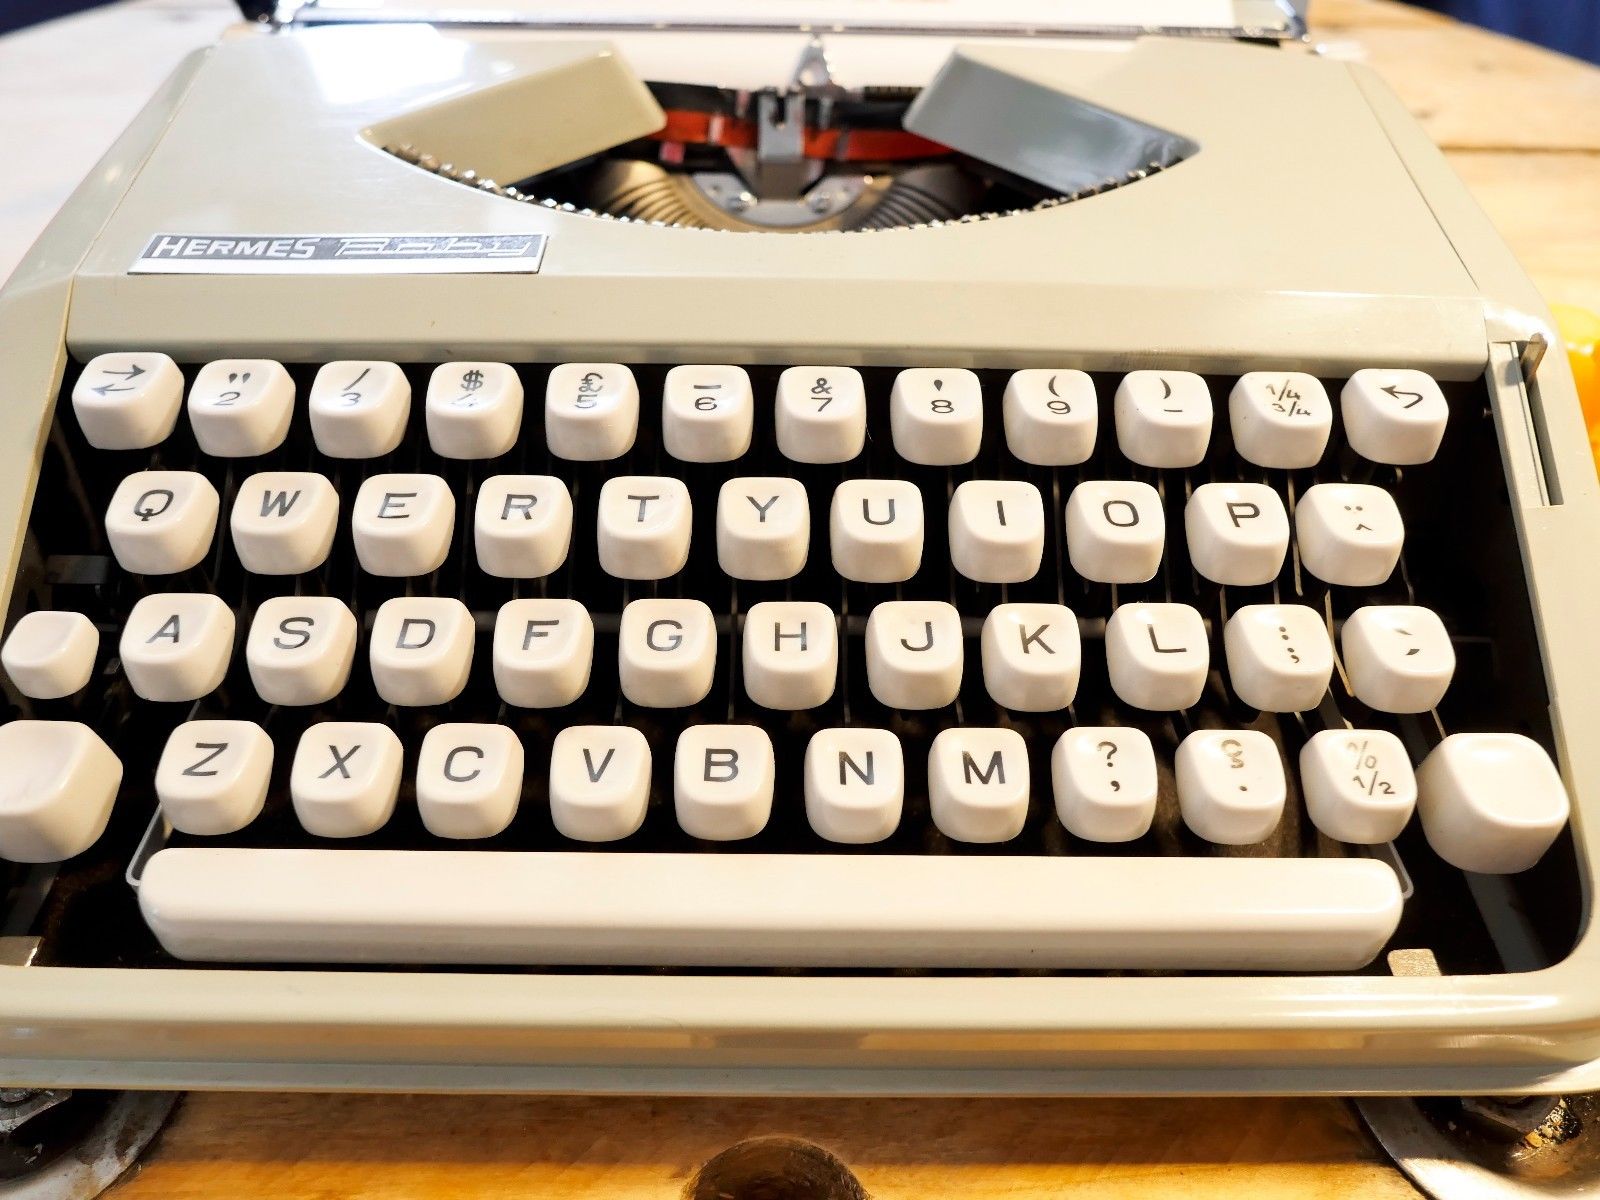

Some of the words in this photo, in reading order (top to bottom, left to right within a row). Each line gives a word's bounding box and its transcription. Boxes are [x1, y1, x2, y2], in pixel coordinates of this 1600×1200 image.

[151, 236, 321, 259] HERMES
[460, 369, 485, 391] $
[578, 372, 604, 392] £
[811, 377, 832, 394] &
[1048, 376, 1059, 396] (
[1160, 378, 1171, 399] )
[213, 391, 241, 406] 2
[341, 389, 362, 406] 3
[574, 394, 598, 409] 5
[695, 397, 717, 411] 6
[811, 397, 832, 412] 7
[931, 400, 954, 413] 8
[1047, 401, 1071, 414] 9
[133, 489, 174, 521] Q
[260, 490, 301, 517] W
[377, 492, 417, 519] E
[501, 494, 537, 520] R
[628, 495, 660, 522] T
[746, 496, 779, 522] Y
[863, 498, 895, 525] U
[997, 500, 1006, 526] I
[1103, 500, 1139, 527] O
[1226, 502, 1260, 528] P
[146, 615, 180, 643] A
[273, 617, 314, 649] S
[396, 618, 436, 649] D
[522, 620, 559, 650] F
[647, 619, 683, 651] G
[774, 621, 807, 651] H
[900, 621, 933, 651] J
[1019, 624, 1056, 654] K
[1147, 624, 1187, 653] L
[182, 742, 229, 776] Z
[318, 745, 361, 779] X
[444, 746, 484, 782] C
[583, 748, 615, 783] V
[704, 748, 738, 782] B
[1098, 741, 1117, 767] ?
[839, 751, 874, 785] N
[962, 751, 1006, 785] M
